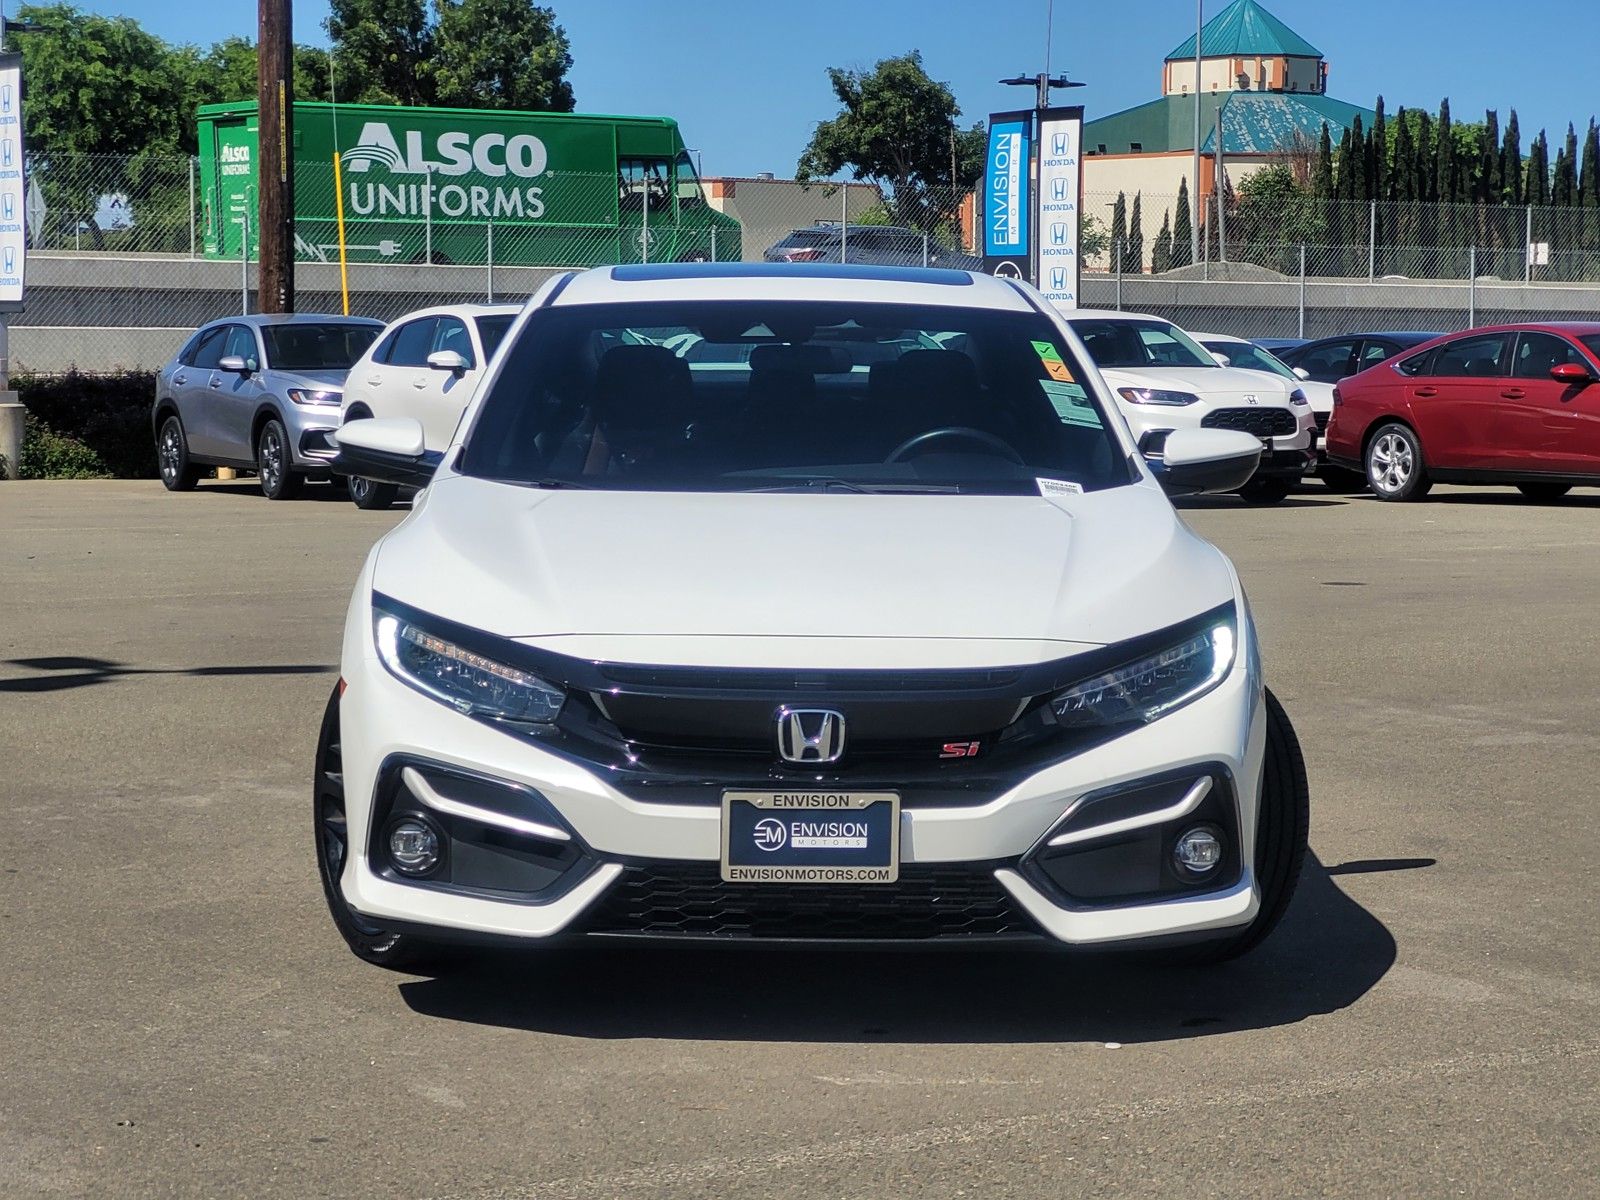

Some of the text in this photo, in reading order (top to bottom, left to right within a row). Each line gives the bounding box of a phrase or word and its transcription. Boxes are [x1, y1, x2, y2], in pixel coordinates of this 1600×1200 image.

[340, 122, 548, 178] ALSCO
[1043, 158, 1076, 167] HONDA
[993, 133, 1011, 245] ENVISION
[1010, 143, 1018, 235] MOTORS
[350, 182, 545, 218] UNIFORMS
[1043, 203, 1074, 212] HONDA
[1042, 248, 1074, 256] HONDA
[939, 741, 980, 758] Si
[773, 794, 850, 807] ENVISION
[791, 822, 868, 837] ENVISION
[730, 868, 890, 881] ENVISIONMOTORS.COM
